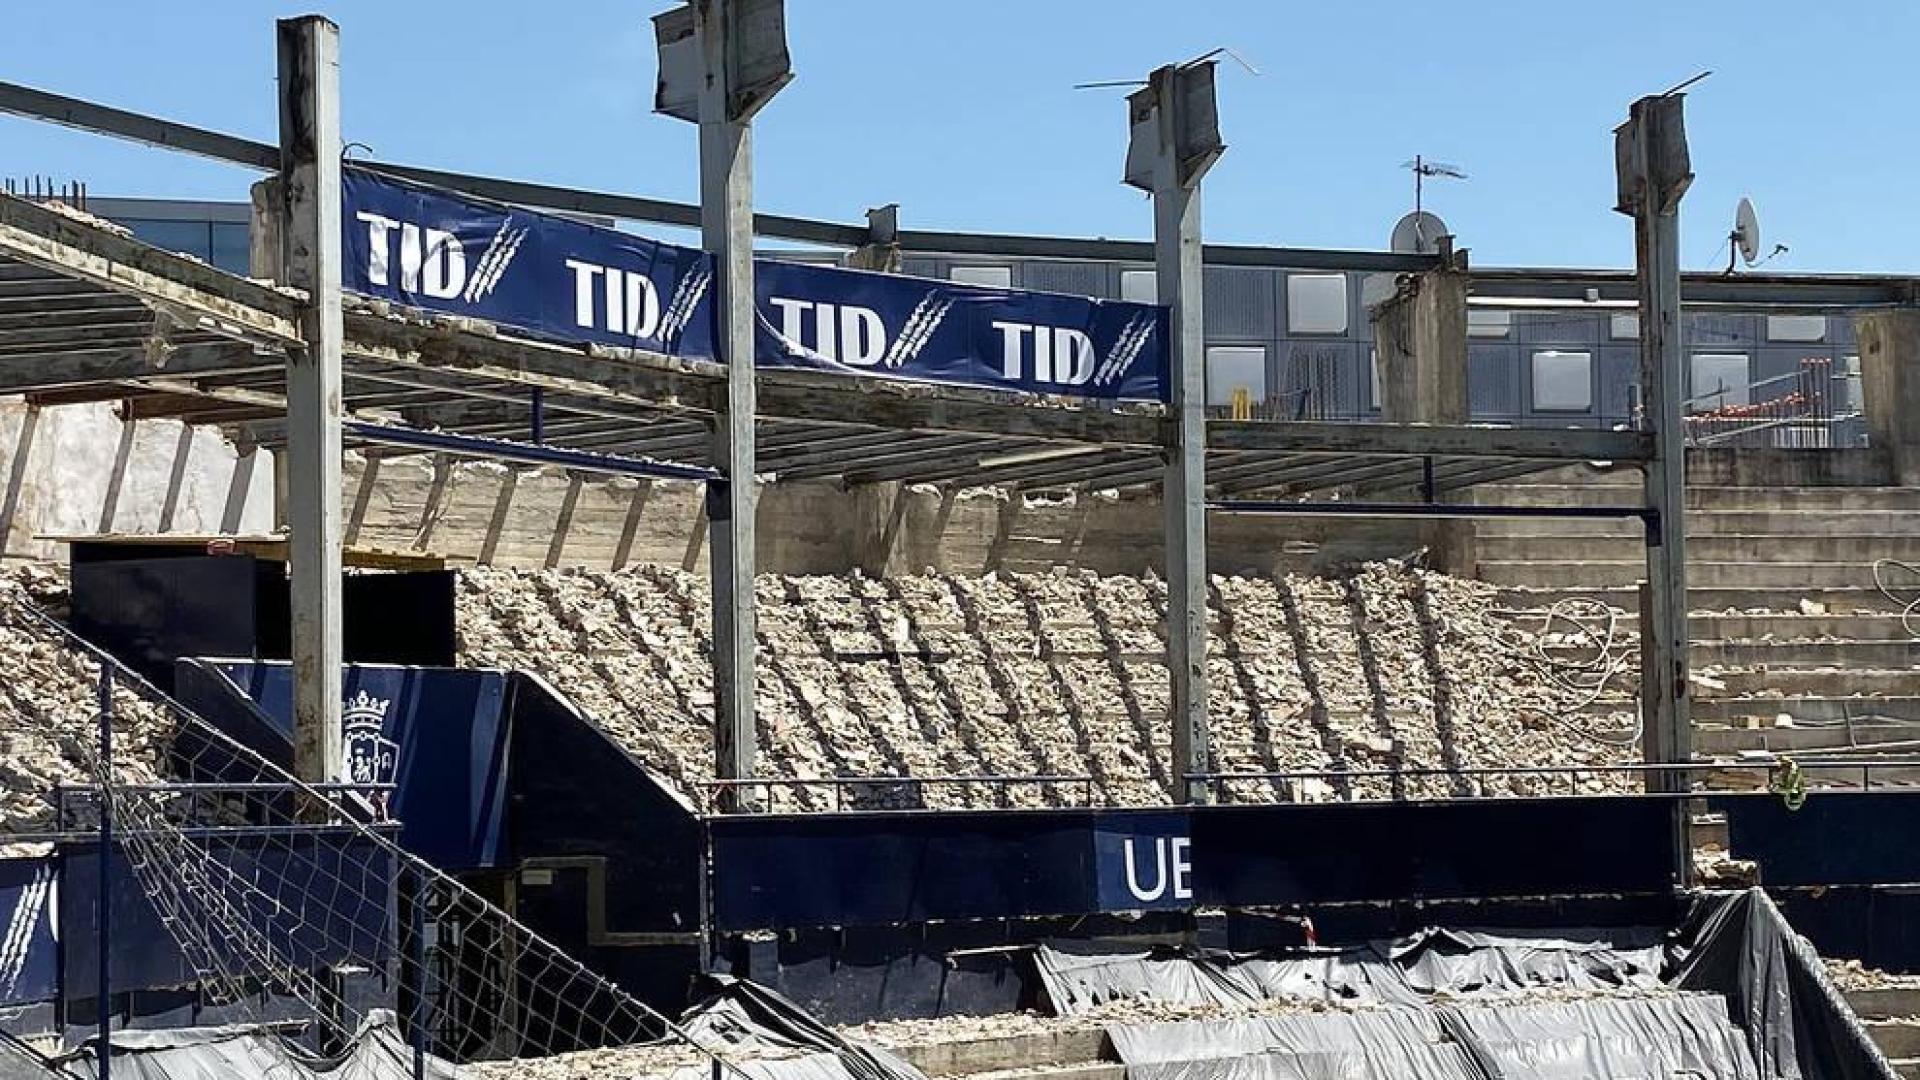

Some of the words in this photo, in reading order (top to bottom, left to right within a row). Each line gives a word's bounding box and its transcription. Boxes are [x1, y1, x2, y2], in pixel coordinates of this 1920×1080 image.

[356, 211, 467, 300] TID
[565, 259, 660, 339] TID
[770, 298, 887, 366] TID
[992, 322, 1095, 386] TID
[1124, 837, 1192, 901] UE
